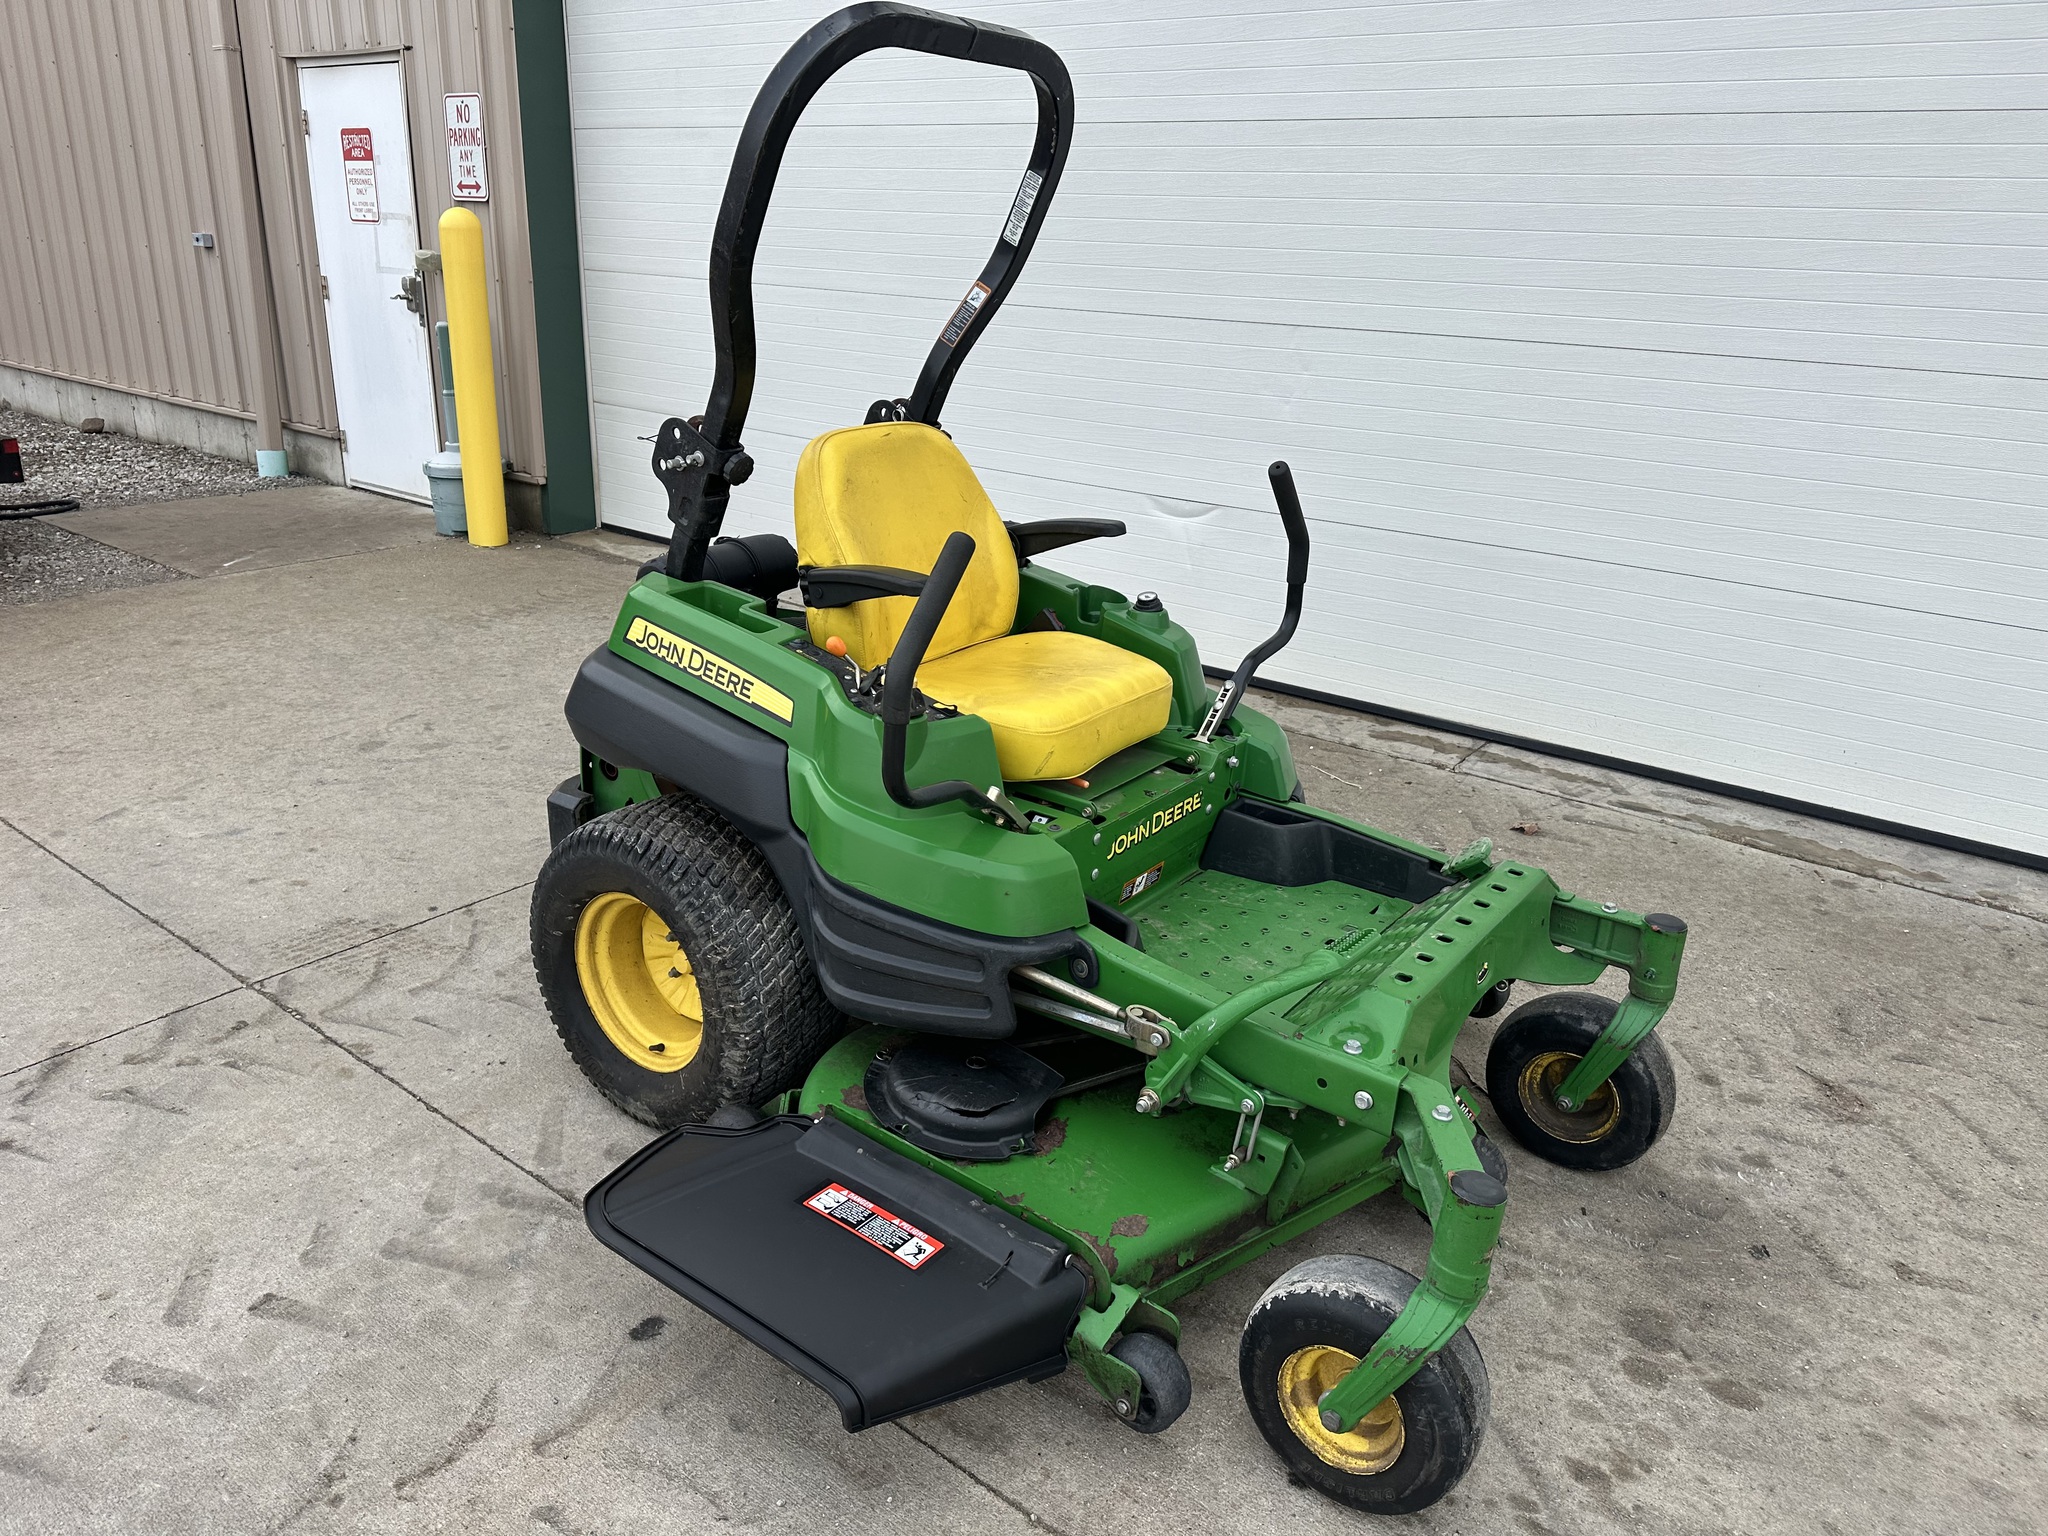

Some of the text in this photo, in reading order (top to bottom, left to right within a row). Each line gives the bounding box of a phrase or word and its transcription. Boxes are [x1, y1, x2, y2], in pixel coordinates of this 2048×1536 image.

[456, 104, 470, 123] NO
[342, 133, 371, 151] RESTRICTED
[449, 127, 480, 147] PARKING
[351, 148, 365, 158] AREA
[460, 149, 473, 162] ANY
[348, 168, 373, 176] AUTHORIZED
[459, 164, 477, 178] TIME
[349, 177, 373, 186] PERSONNEL
[356, 187, 367, 196] ONLY
[635, 624, 754, 700] JOHN DEERE
[1106, 792, 1202, 860] JOHN DEERE
[847, 1192, 875, 1209] DANGER
[898, 1220, 929, 1240] PELIGRO
